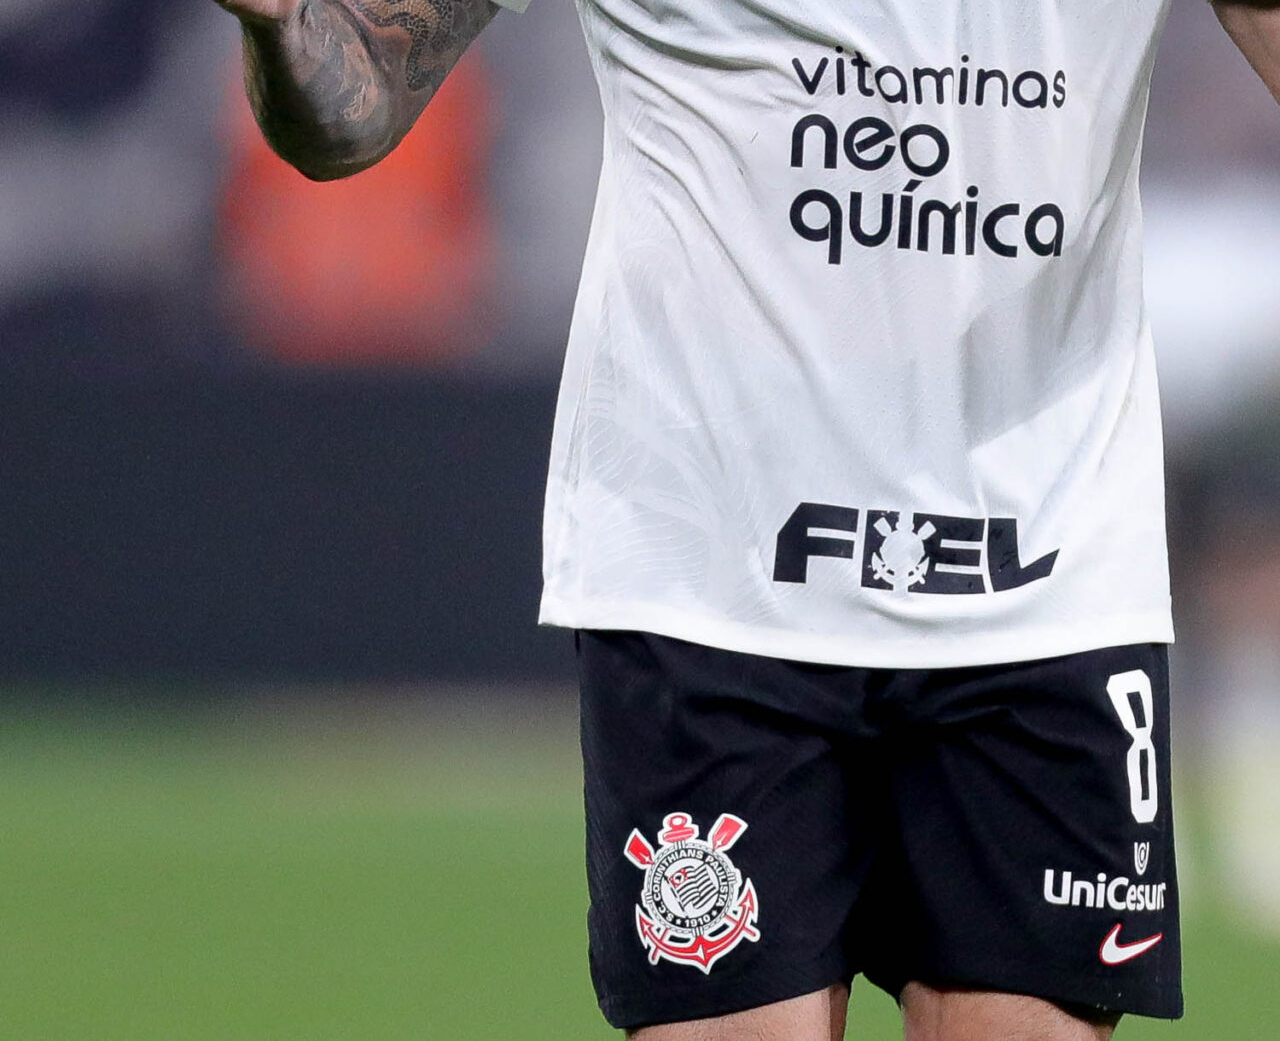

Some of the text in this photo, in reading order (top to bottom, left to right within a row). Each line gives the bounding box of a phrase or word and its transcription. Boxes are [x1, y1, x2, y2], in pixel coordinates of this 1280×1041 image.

[791, 45, 1067, 109] vitaminas
[789, 113, 950, 178] neo
[789, 179, 1066, 265] química
[1105, 668, 1159, 824] 8
[652, 849, 704, 901] CORINTHIANS
[705, 855, 728, 907] PAULISTA
[684, 914, 711, 927] 1910
